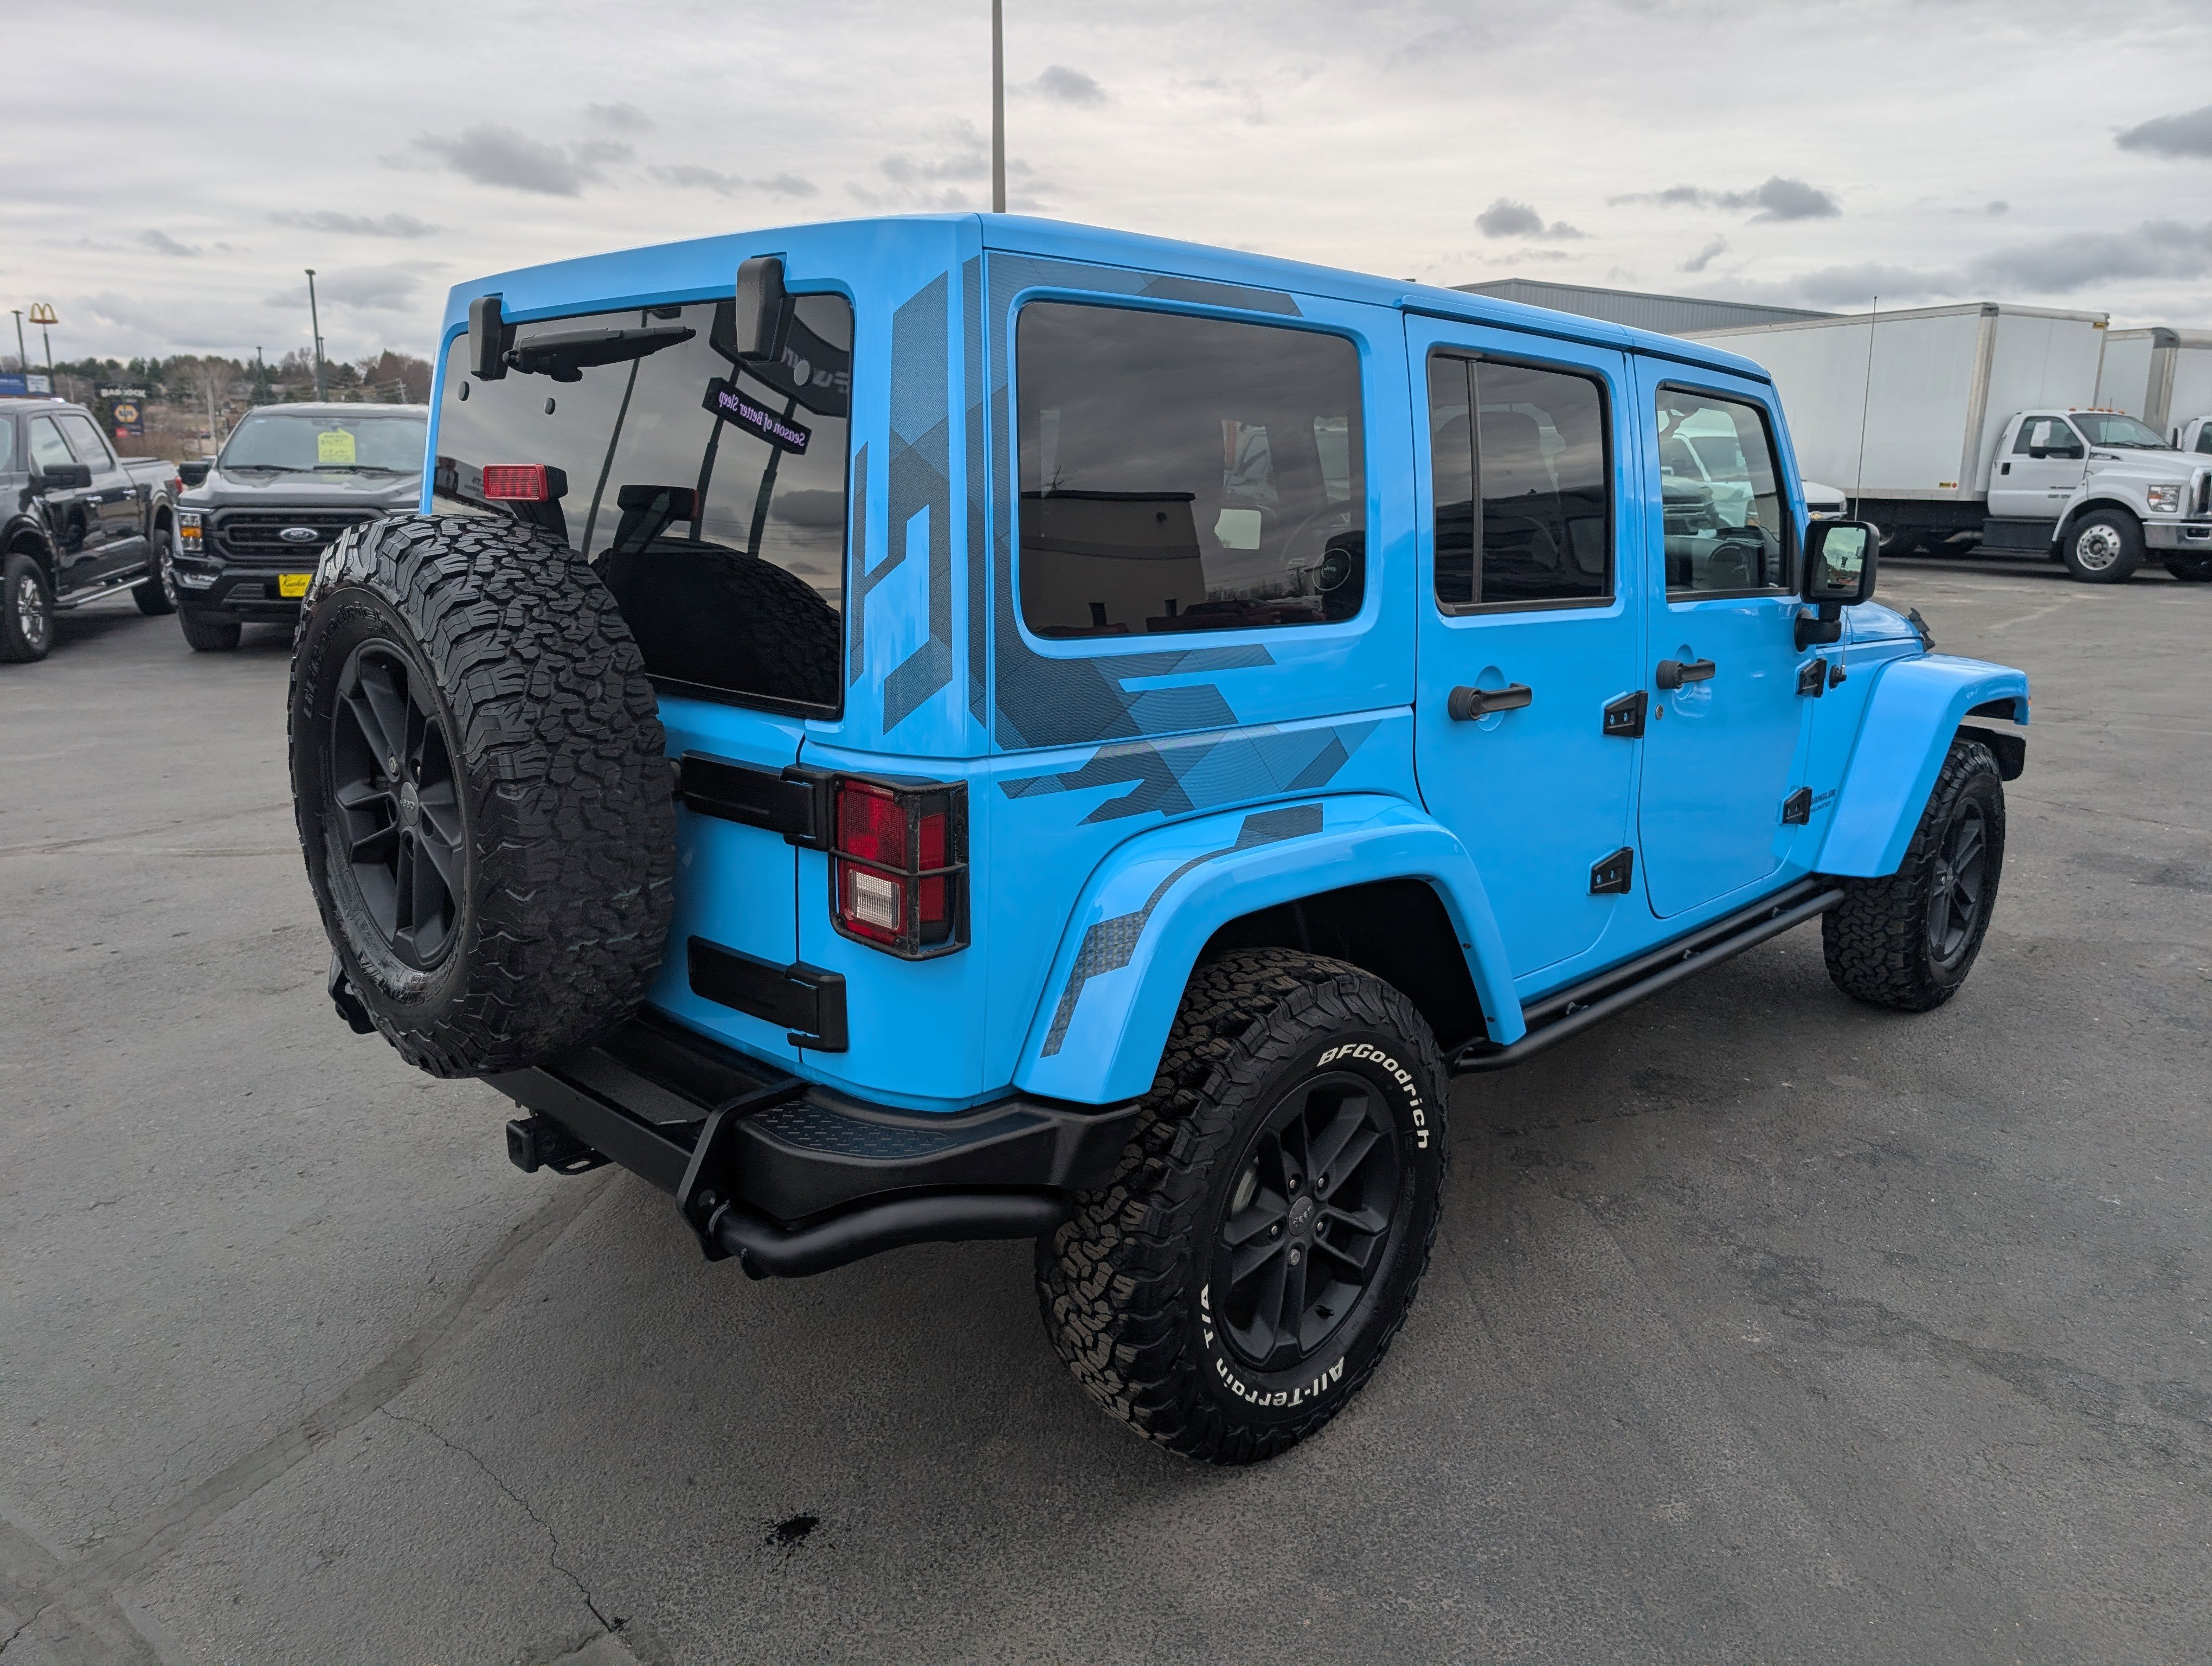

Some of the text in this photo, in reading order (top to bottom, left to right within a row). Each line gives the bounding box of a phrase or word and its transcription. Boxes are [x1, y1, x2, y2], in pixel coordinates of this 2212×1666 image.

[1316, 1043, 1429, 1148] BFGoodrich
[1201, 1283, 1344, 1407] All-Terrain T/A
